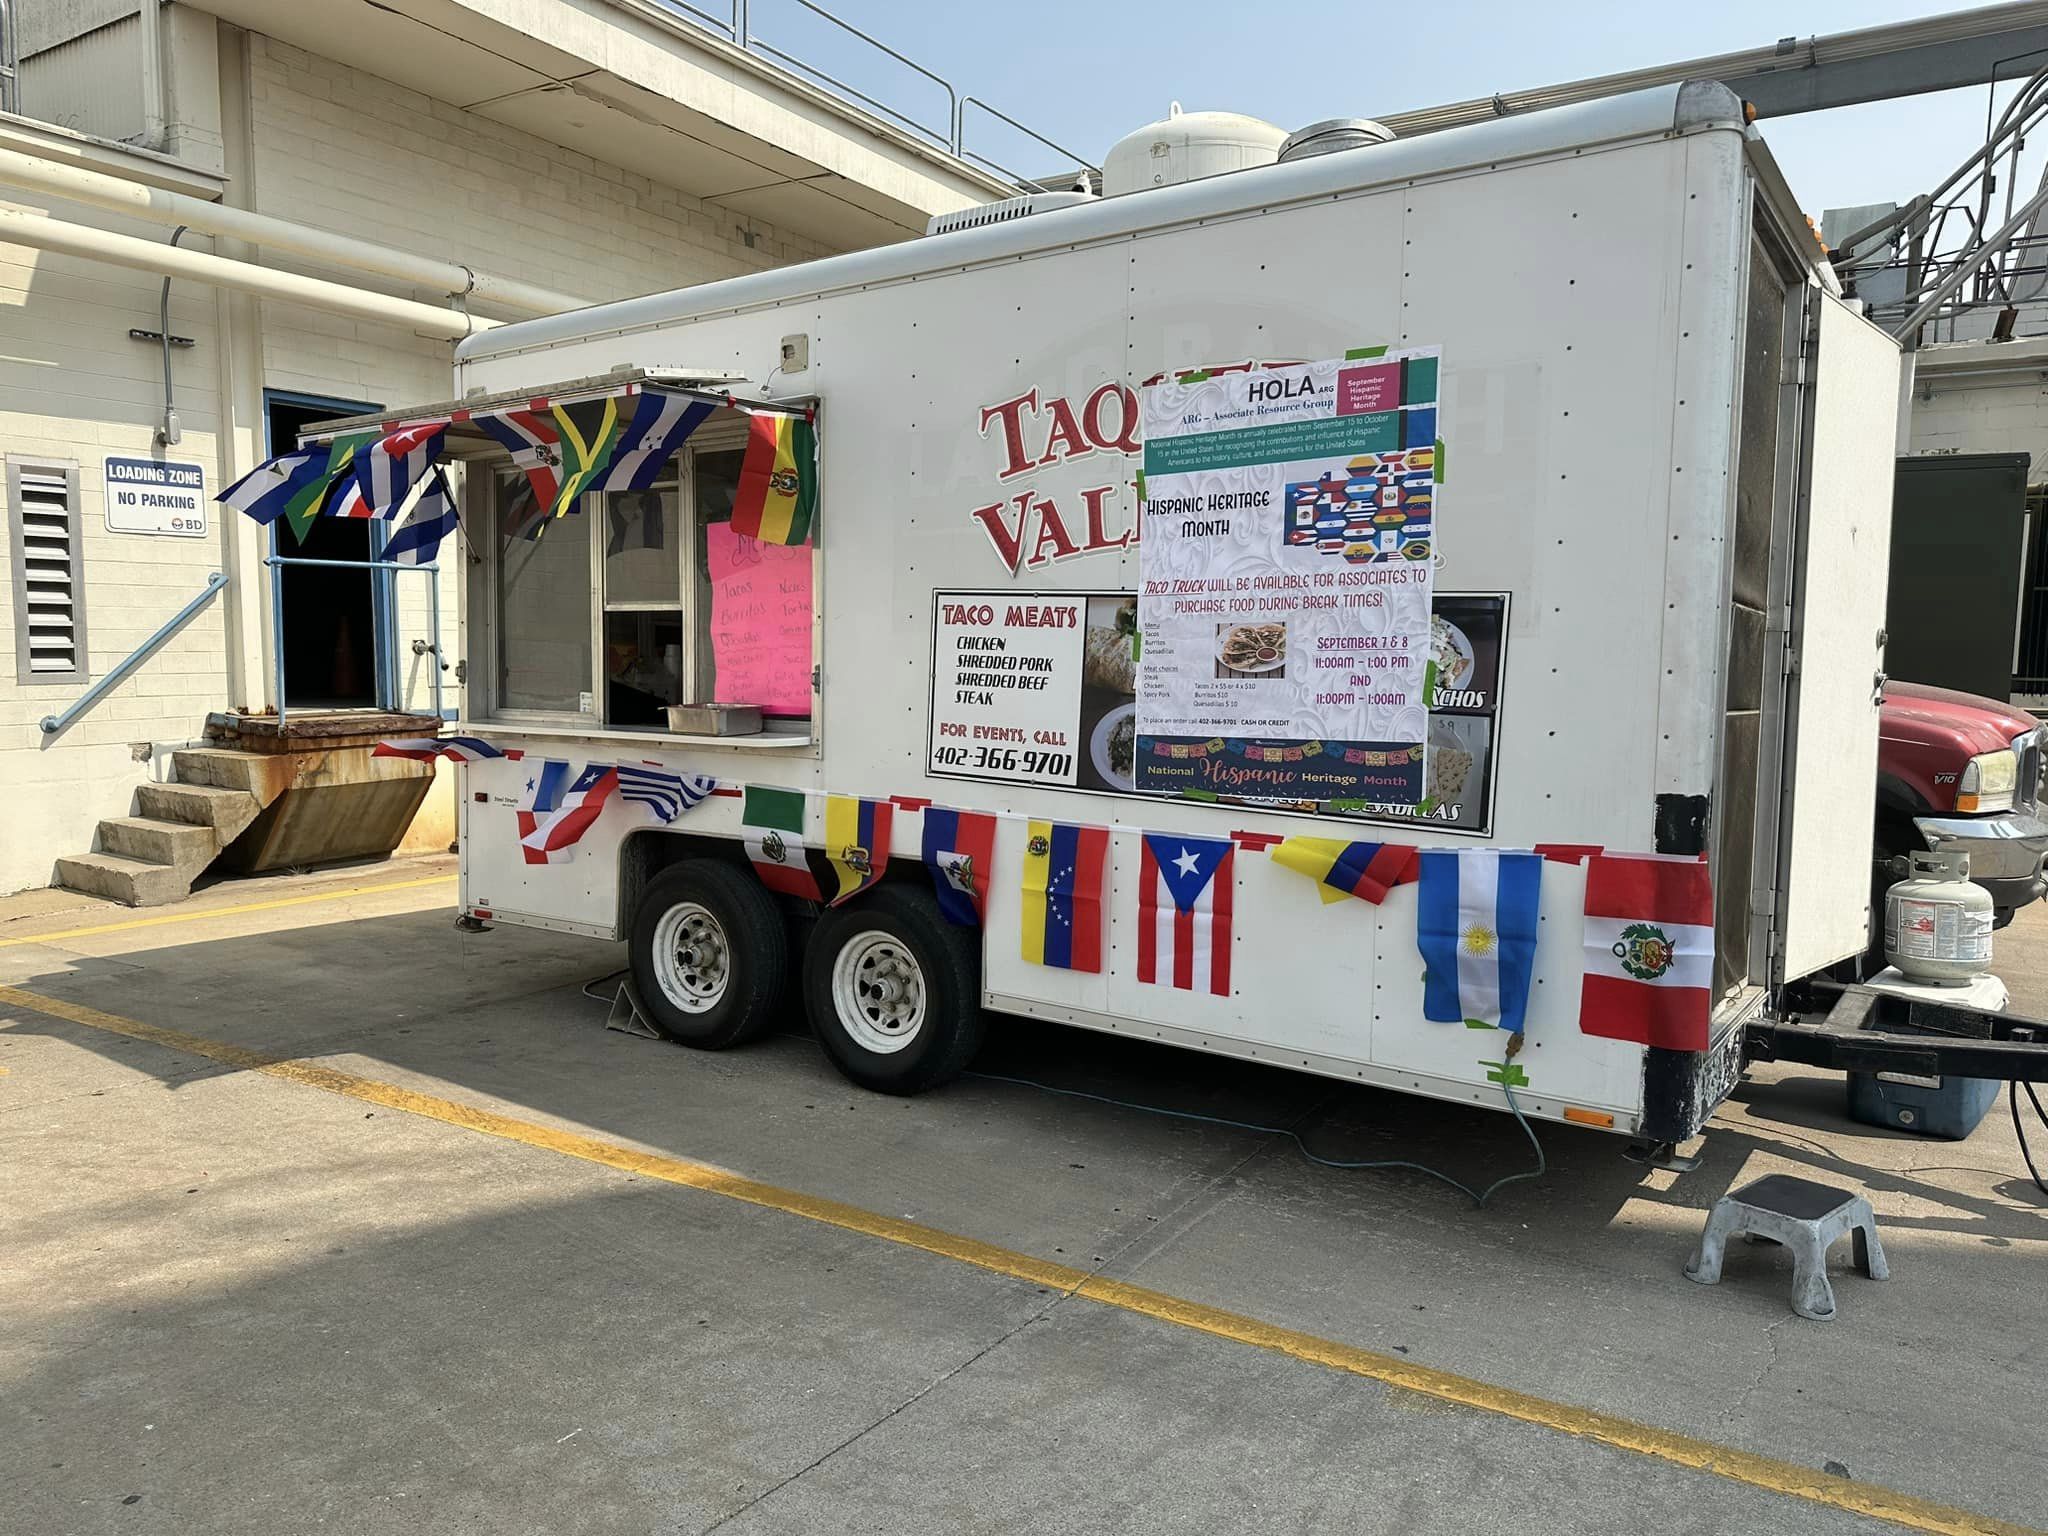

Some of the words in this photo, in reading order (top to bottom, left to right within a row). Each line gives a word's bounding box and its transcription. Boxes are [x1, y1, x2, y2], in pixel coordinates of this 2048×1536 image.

[1249, 376, 1315, 402] HOLA
[1318, 385, 1334, 394] ARG
[1347, 377, 1385, 387] September
[1350, 385, 1382, 394] Hispanic
[1350, 394, 1380, 402] Heritage
[1182, 414, 1202, 424] ARG
[1214, 408, 1254, 420] Associate
[1257, 404, 1300, 415] Resource
[1303, 399, 1334, 410] Group
[979, 380, 1142, 484] TAQ
[1151, 440, 1172, 448] National
[1172, 438, 1194, 446] Hispanic
[1196, 435, 1217, 444] Heritage
[1219, 432, 1236, 441] Month
[1244, 428, 1266, 438] annually
[1268, 425, 1296, 434] celebrated
[1298, 424, 1312, 432] from
[1314, 419, 1346, 430] September
[1364, 414, 1388, 424] October
[1180, 447, 1198, 456] United
[1198, 446, 1215, 454] States
[1224, 441, 1255, 451] recognizing
[1267, 435, 1304, 446] contributions
[1305, 433, 1316, 441] and
[1318, 430, 1344, 440] influence
[1346, 428, 1354, 436] of
[1354, 426, 1380, 436] Hispanic
[1168, 458, 1194, 466] Americans
[1254, 449, 1264, 457] and
[1266, 446, 1304, 456] achievements
[1314, 442, 1324, 450] the
[1326, 440, 1346, 449] United
[1347, 438, 1366, 447] States
[108, 463, 165, 482] LOADING
[168, 470, 201, 485] ZONE
[118, 492, 136, 506] NO
[141, 494, 195, 510] PARKING
[1147, 496, 1204, 516] HISPANIC
[1208, 490, 1270, 511] HERITAGE
[185, 520, 203, 530] BD
[1182, 520, 1230, 538] MONTH
[1144, 580, 1169, 595] TACO
[1172, 578, 1206, 594] TRUCK
[1207, 578, 1230, 592] WILL
[1236, 578, 1250, 591] BE
[1254, 574, 1310, 590] AVAILABLE
[1314, 572, 1334, 588] FOR
[1338, 568, 1407, 586] ASSOCIATES
[1412, 568, 1426, 583] TO
[1174, 598, 1225, 614] PURCHASE
[1229, 597, 1256, 612] FOOD
[1258, 596, 1298, 611] DURING
[1302, 594, 1338, 609] BREAK
[1343, 592, 1384, 608] TIMES!
[942, 604, 994, 626] TACO
[1004, 606, 1078, 629] MEATS
[956, 636, 1007, 651] CHICKEN
[1317, 636, 1378, 649] SEPTEMBER
[1382, 636, 1387, 648] 7
[1390, 636, 1398, 648] &
[1402, 636, 1408, 648] 8
[956, 654, 1017, 670] SHREDDED
[1018, 656, 1054, 672] PORK
[1315, 656, 1354, 669] 11:00AM
[1367, 656, 1386, 668] 1:00
[1391, 656, 1409, 668] PM
[954, 672, 1016, 689] SHREDDED
[1018, 675, 1049, 690] BEEF
[1350, 675, 1372, 687] AND
[954, 690, 994, 706] STEAK
[1316, 692, 1354, 705] 11:00PM
[1368, 693, 1406, 705] 1:00AM
[1432, 689, 1488, 709] ACHOS
[940, 722, 968, 738] FOR
[972, 725, 1028, 745] EVENTS,
[1033, 730, 1068, 746] CALL
[934, 746, 1073, 777] 402-366-9701
[1148, 766, 1194, 777] National
[1200, 757, 1297, 786] Hispanic
[1301, 772, 1358, 786] Heritage
[1364, 774, 1408, 787] Month
[1934, 775, 1956, 785] V10
